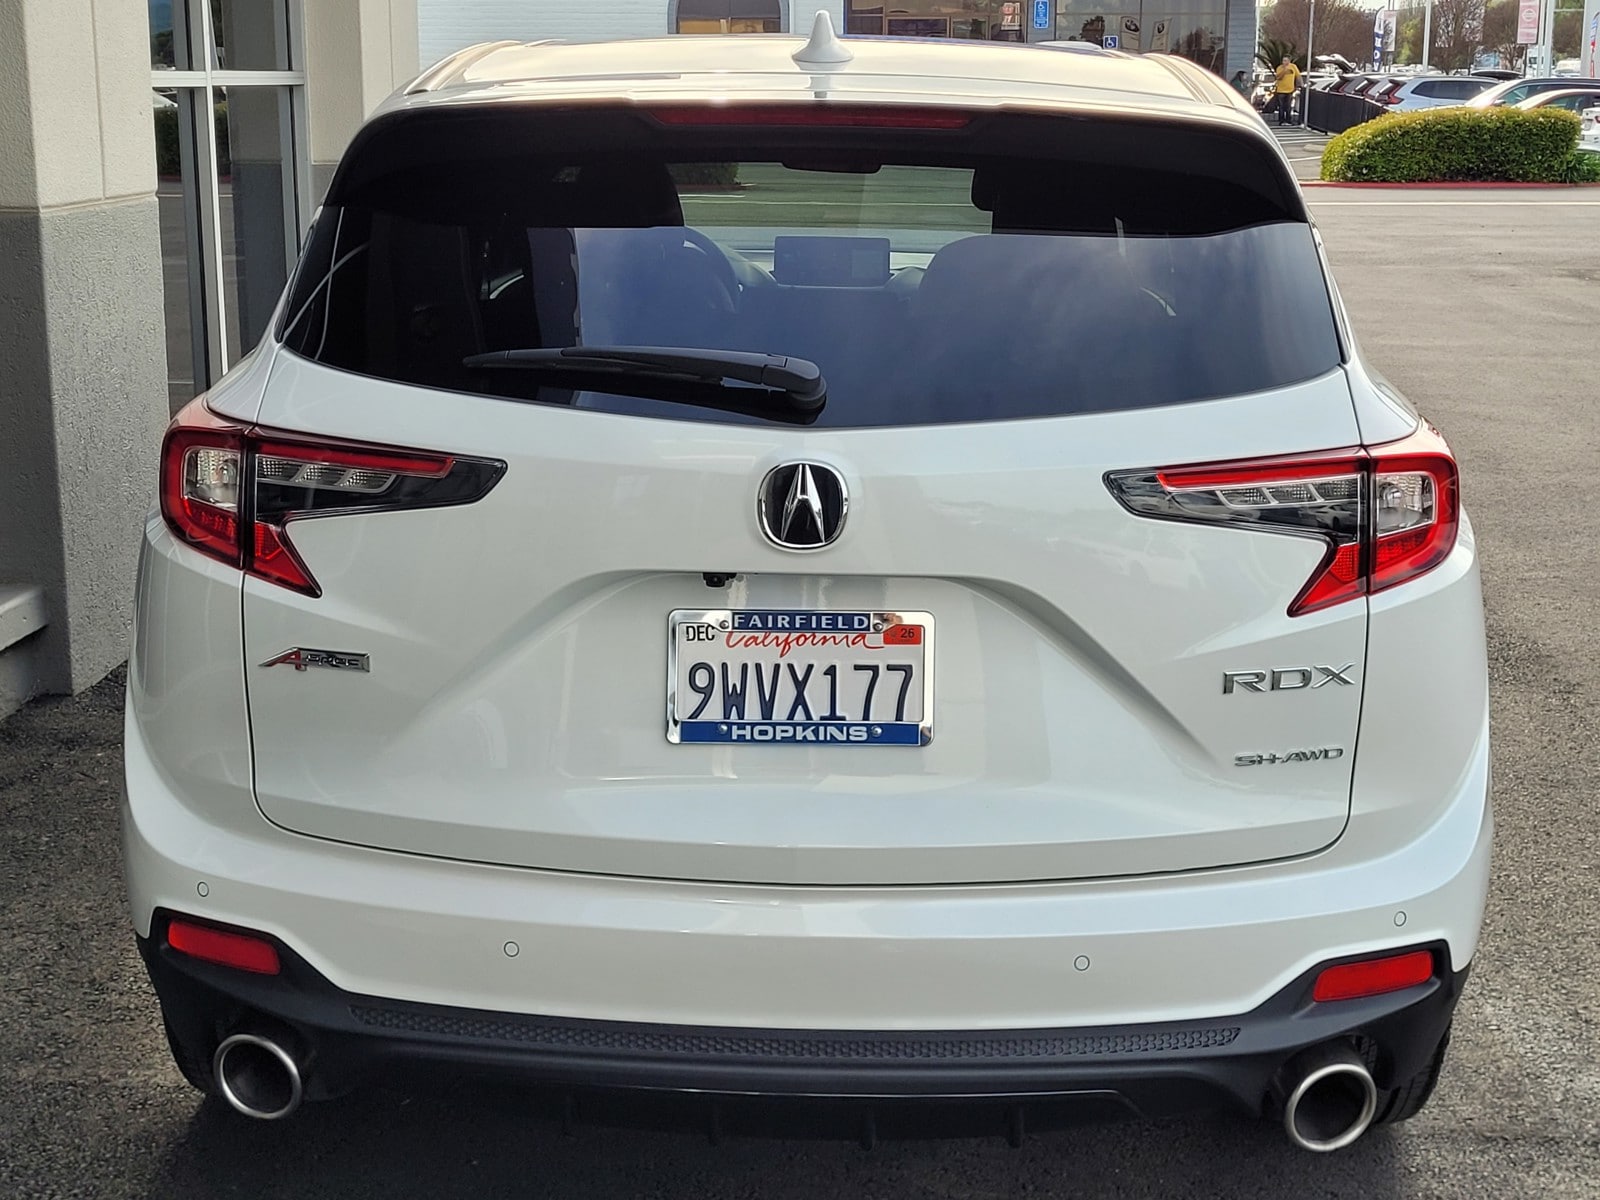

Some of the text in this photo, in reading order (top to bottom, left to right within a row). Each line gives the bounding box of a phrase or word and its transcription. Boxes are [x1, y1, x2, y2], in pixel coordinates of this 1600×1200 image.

[734, 614, 868, 630] FAIRFIELD
[686, 625, 715, 641] DEC
[900, 628, 914, 639] 26
[726, 631, 884, 658] California
[1223, 662, 1356, 694] RDX
[688, 662, 914, 721] 9WVX177
[732, 725, 868, 741] HOPKINS
[1234, 748, 1343, 767] SH-AWD
